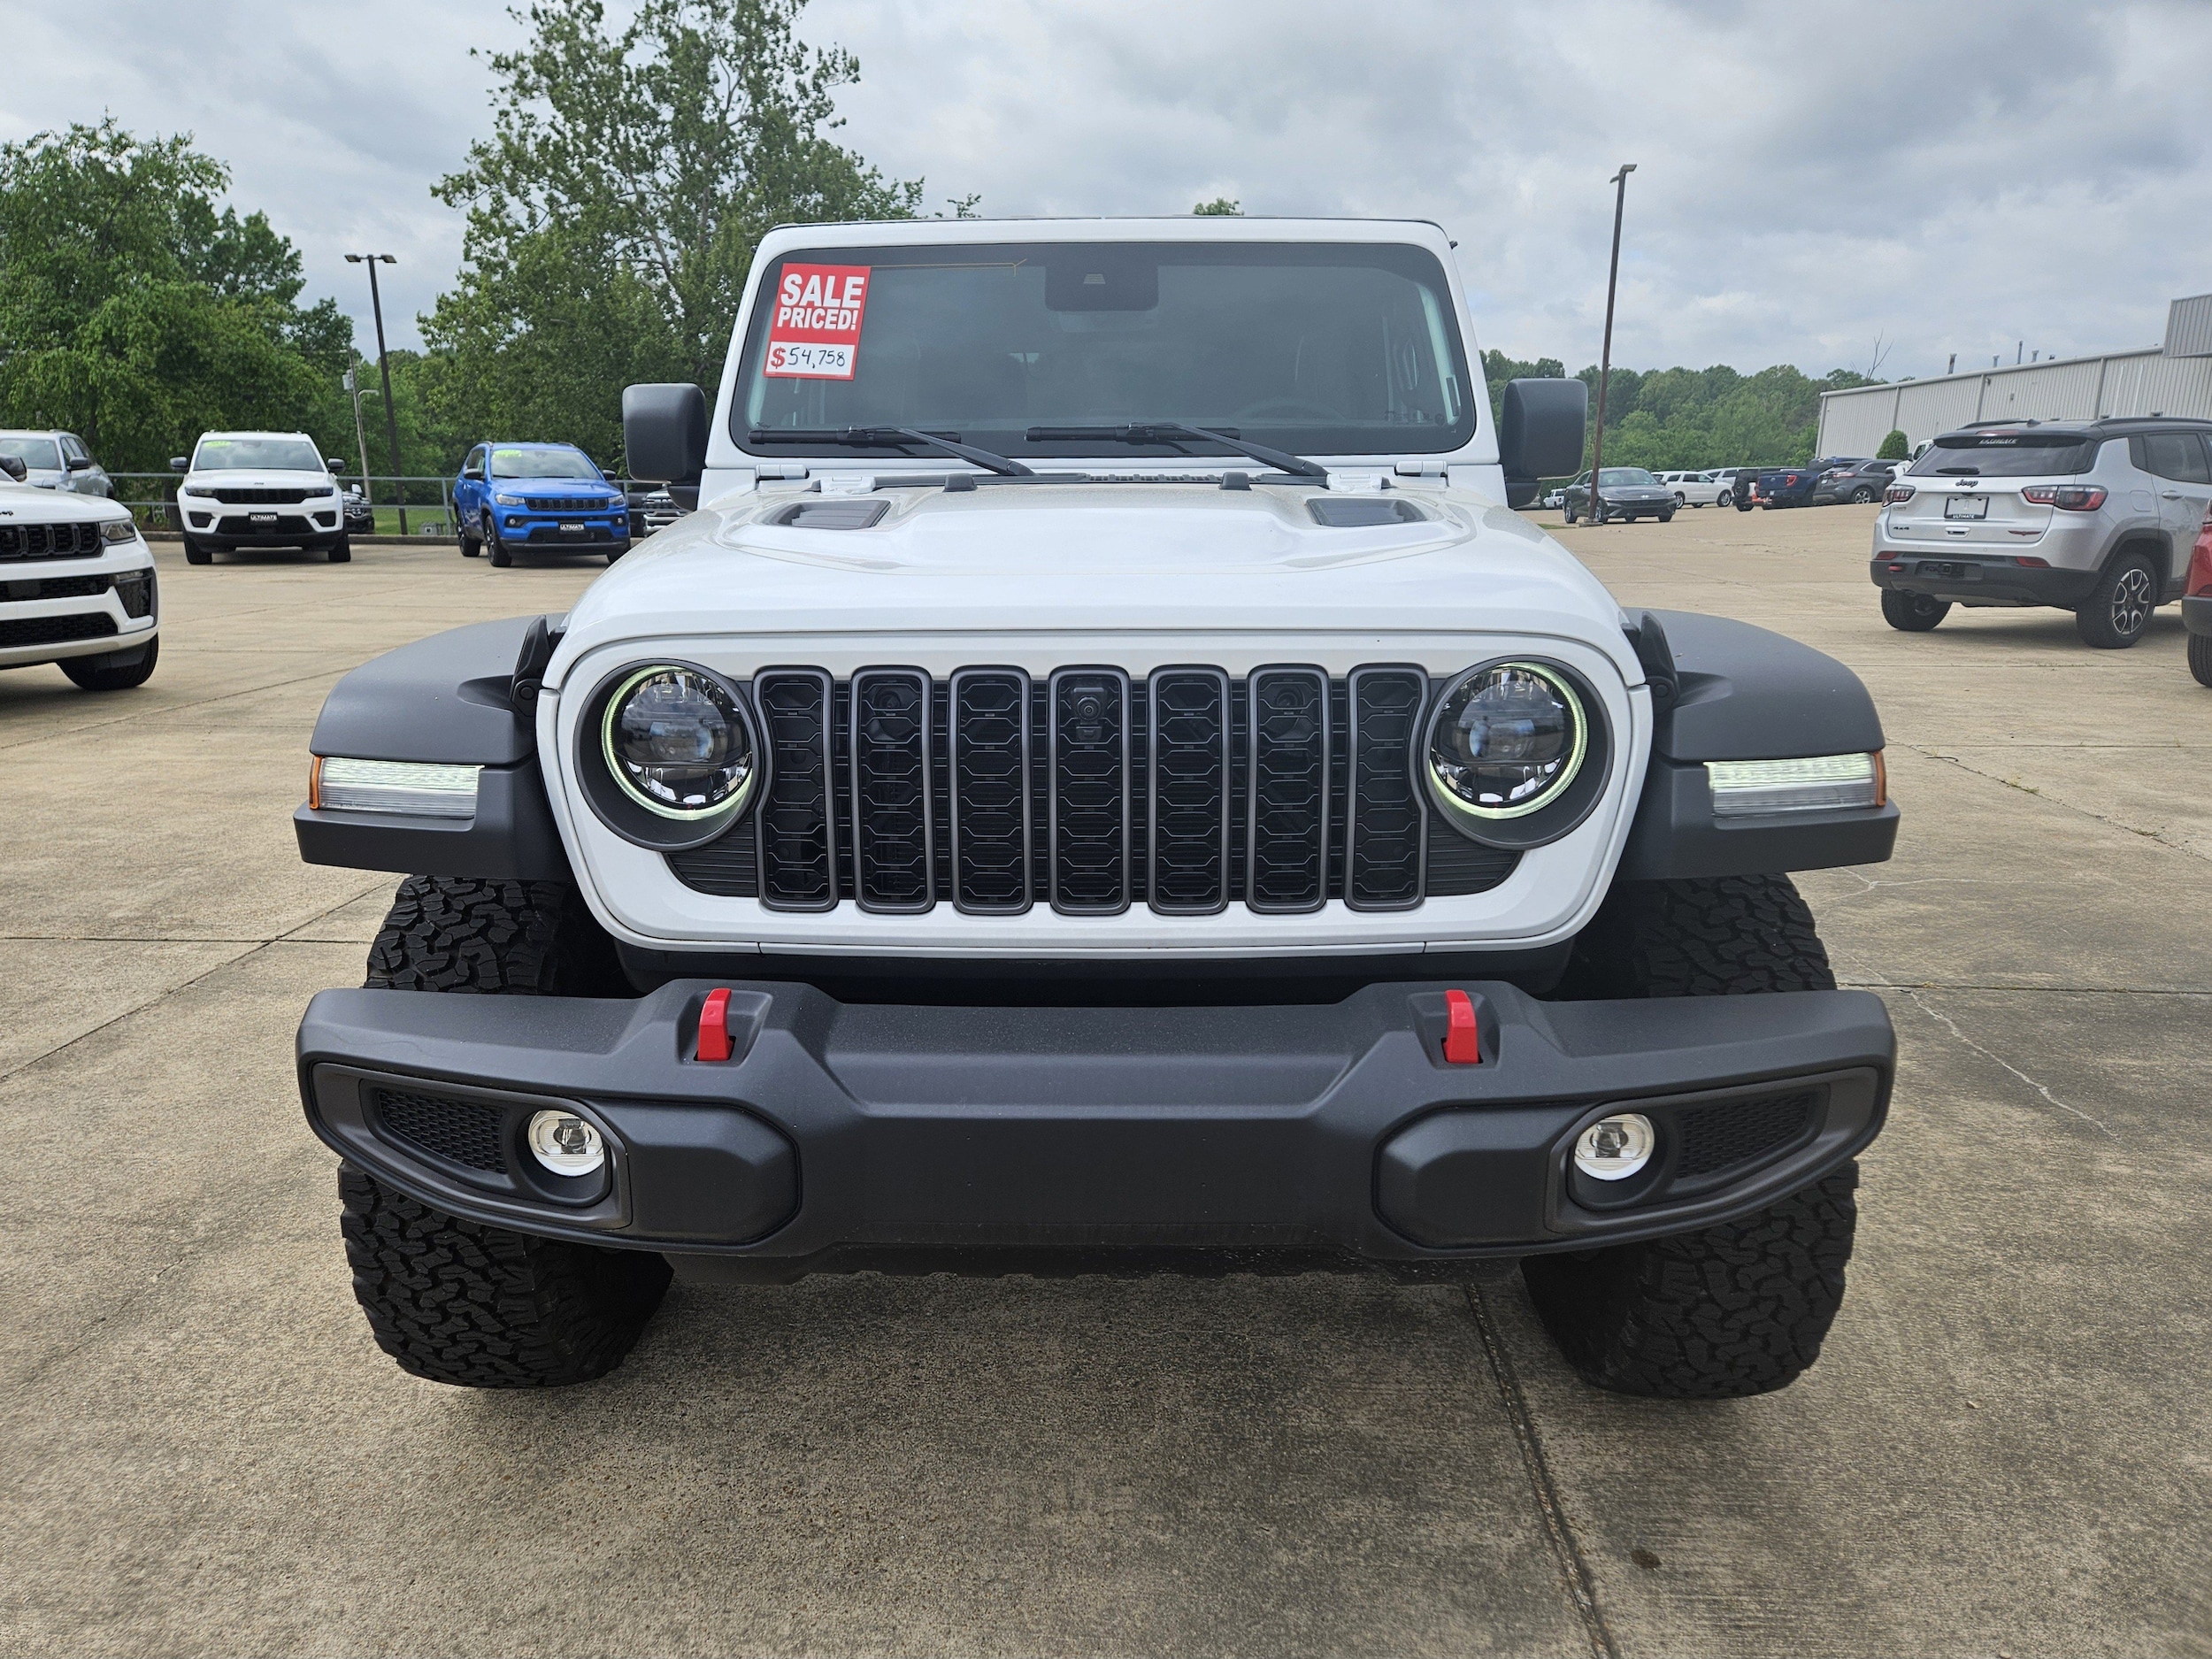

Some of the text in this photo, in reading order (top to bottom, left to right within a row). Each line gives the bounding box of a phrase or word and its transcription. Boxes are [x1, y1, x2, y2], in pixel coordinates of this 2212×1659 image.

[780, 273, 864, 308] SALE
[777, 306, 858, 330] PRICED!
[771, 347, 845, 369] $54,758
[1955, 479, 1978, 488] Jeep
